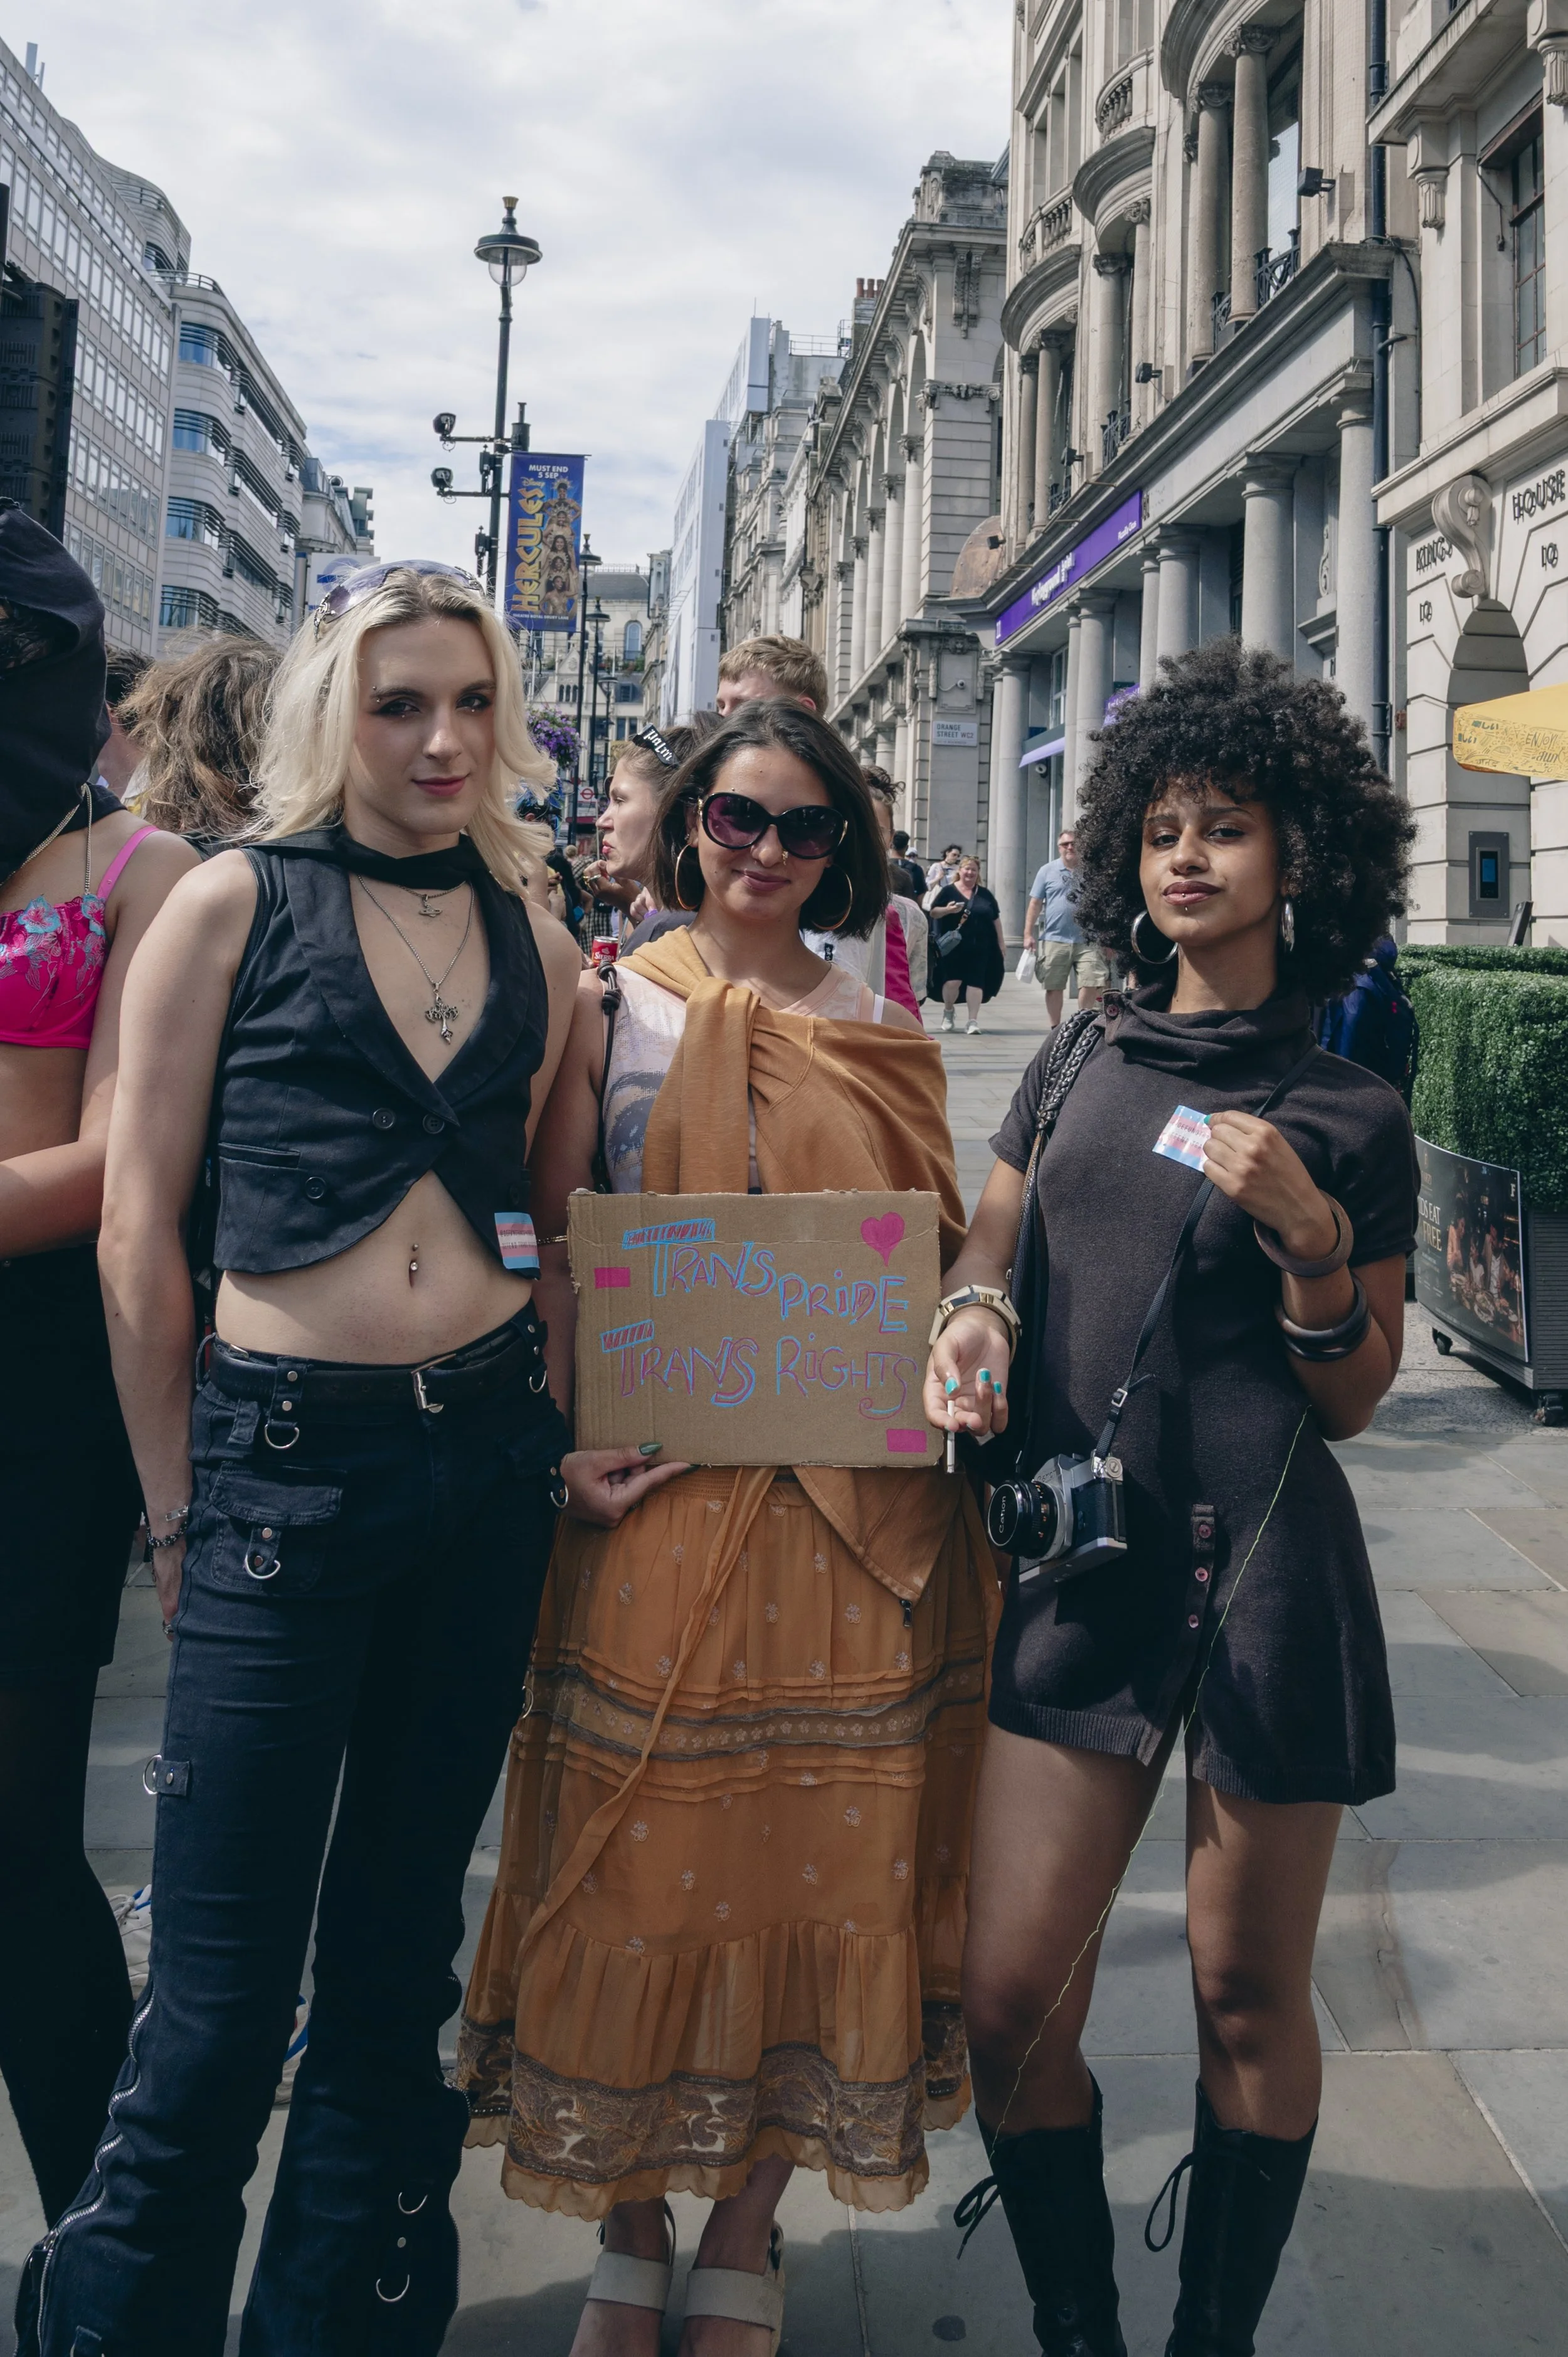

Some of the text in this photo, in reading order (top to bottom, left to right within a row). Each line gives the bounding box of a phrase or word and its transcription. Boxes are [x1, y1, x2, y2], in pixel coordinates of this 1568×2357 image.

[1512, 469, 1565, 523] HOUSE
[595, 951, 615, 961] SIERRA
[1417, 1195, 1441, 1225] IDS EAT
[1423, 1221, 1443, 1251] FREE
[622, 1217, 776, 1297] TRANS
[600, 1319, 760, 1407] TRANS
[999, 1495, 1007, 1533] Canon
